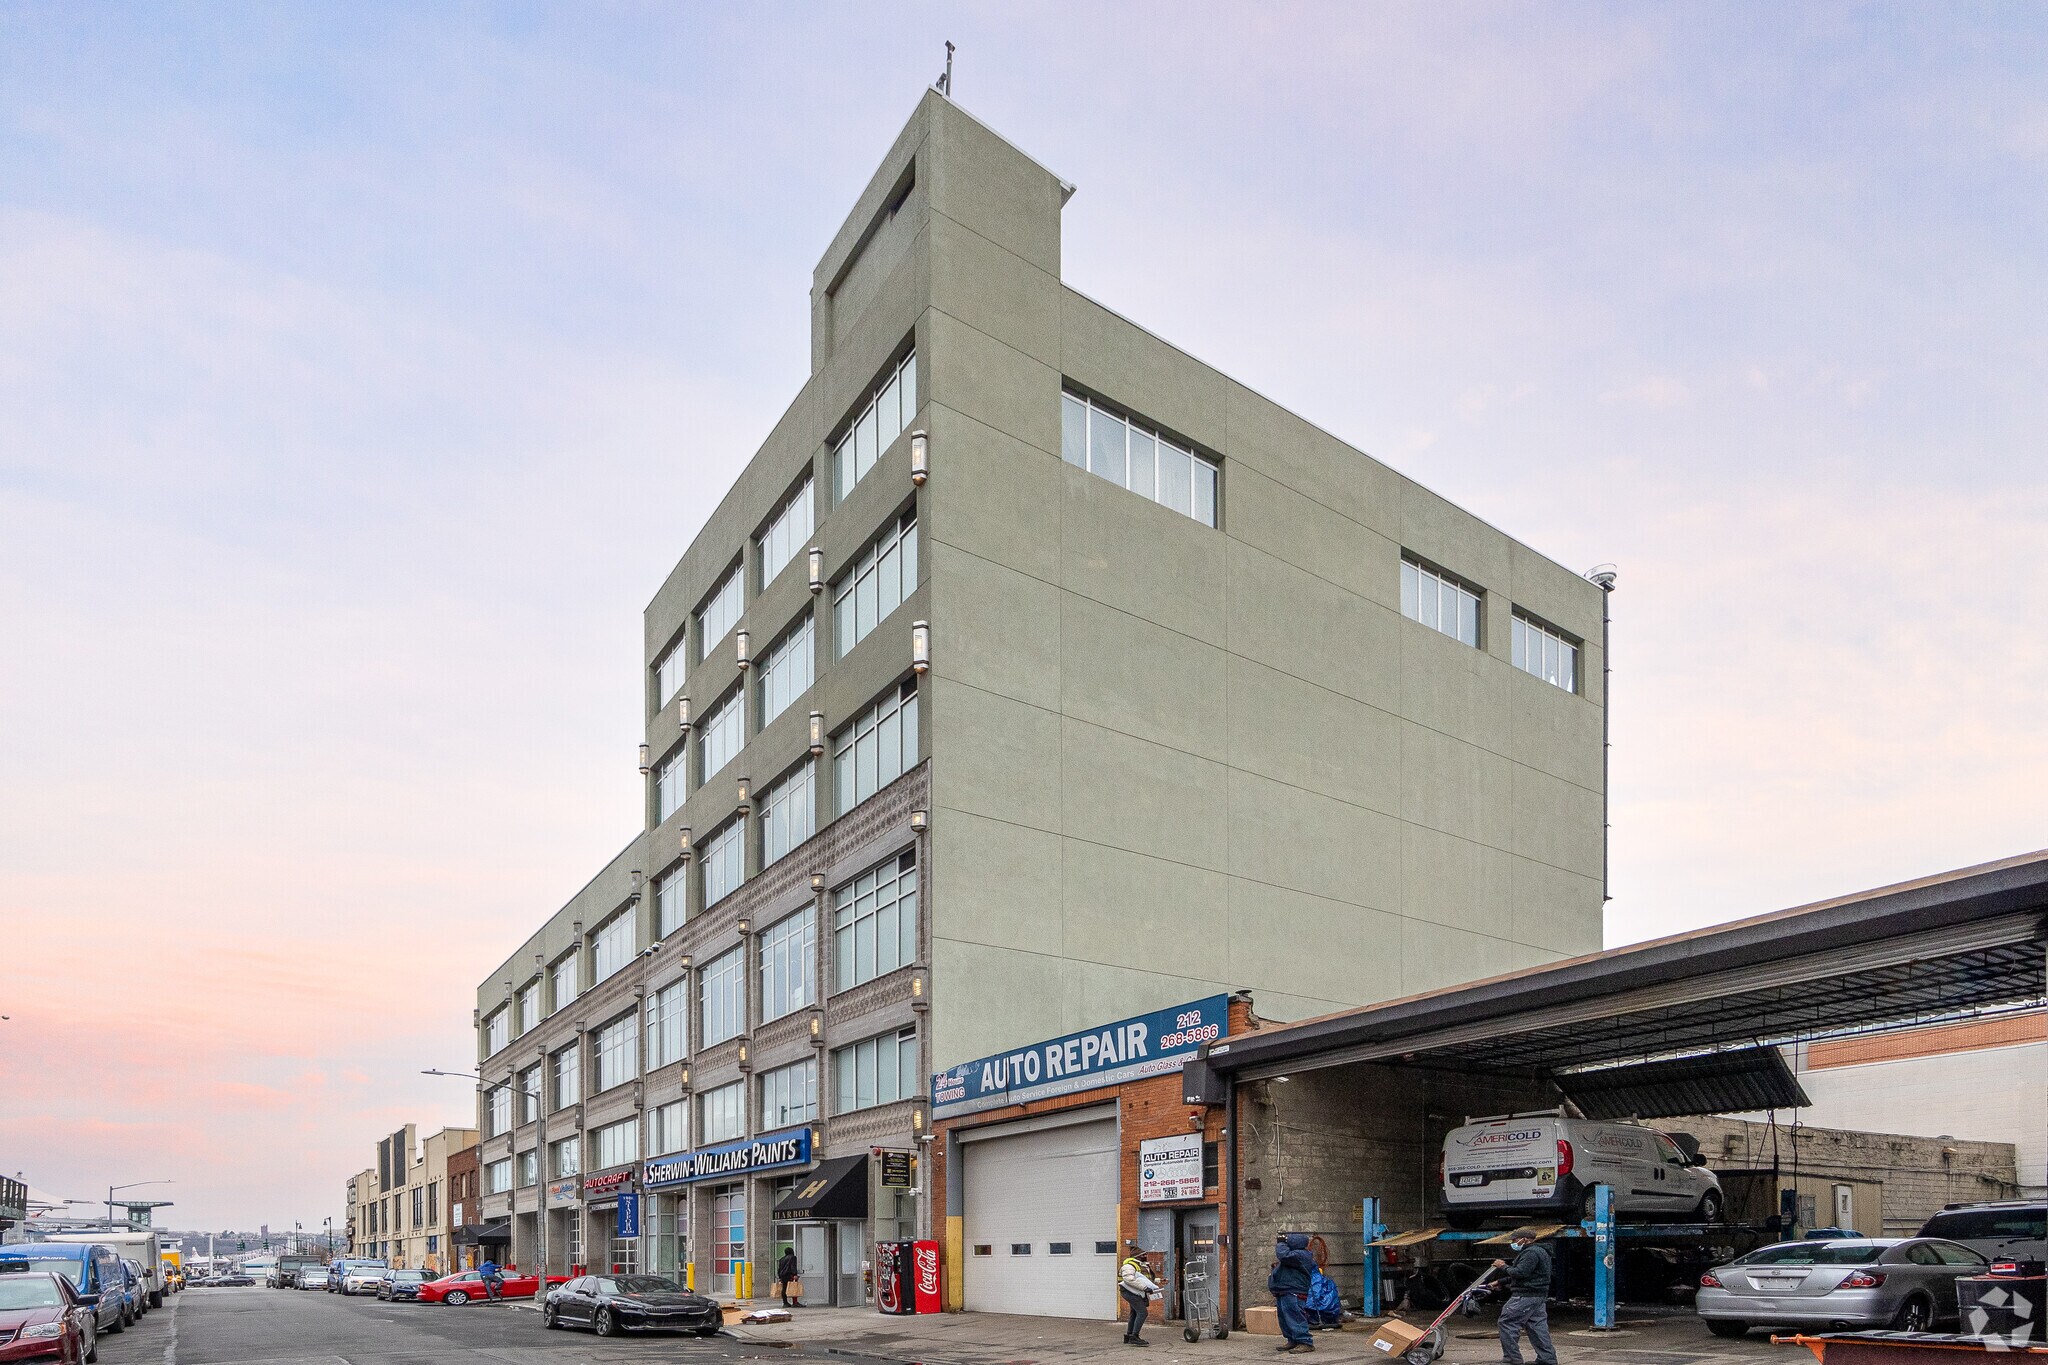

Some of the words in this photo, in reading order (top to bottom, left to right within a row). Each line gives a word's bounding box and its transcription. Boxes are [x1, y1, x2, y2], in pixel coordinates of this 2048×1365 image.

[1177, 1010, 1201, 1028] 212
[1160, 1024, 1219, 1050] 268-5866
[980, 1050, 1040, 1092] AUTO
[1045, 1022, 1148, 1078] REPAIR
[1138, 1064, 1156, 1075] Auto
[1157, 1060, 1177, 1071] Glass
[1177, 1058, 1184, 1067] &
[935, 1072, 948, 1090] 24
[1021, 1086, 1045, 1100] Service
[1046, 1082, 1072, 1094] Foreign
[1073, 1080, 1080, 1088] &
[1081, 1073, 1115, 1087] Domestic
[1116, 1070, 1135, 1080] Cars
[935, 1087, 965, 1103] TOWING
[1474, 1131, 1541, 1146] AMERICOLD
[648, 1147, 749, 1184] SHERWIN-WILLIAMS
[751, 1138, 797, 1166] PAINTS
[1145, 1153, 1167, 1162] AUTO
[1169, 1148, 1199, 1159] REPAIR
[583, 1172, 628, 1189] AUTOCRAFT
[1143, 1177, 1200, 1187] 212-268-5866
[774, 1209, 810, 1220] HARBOR
